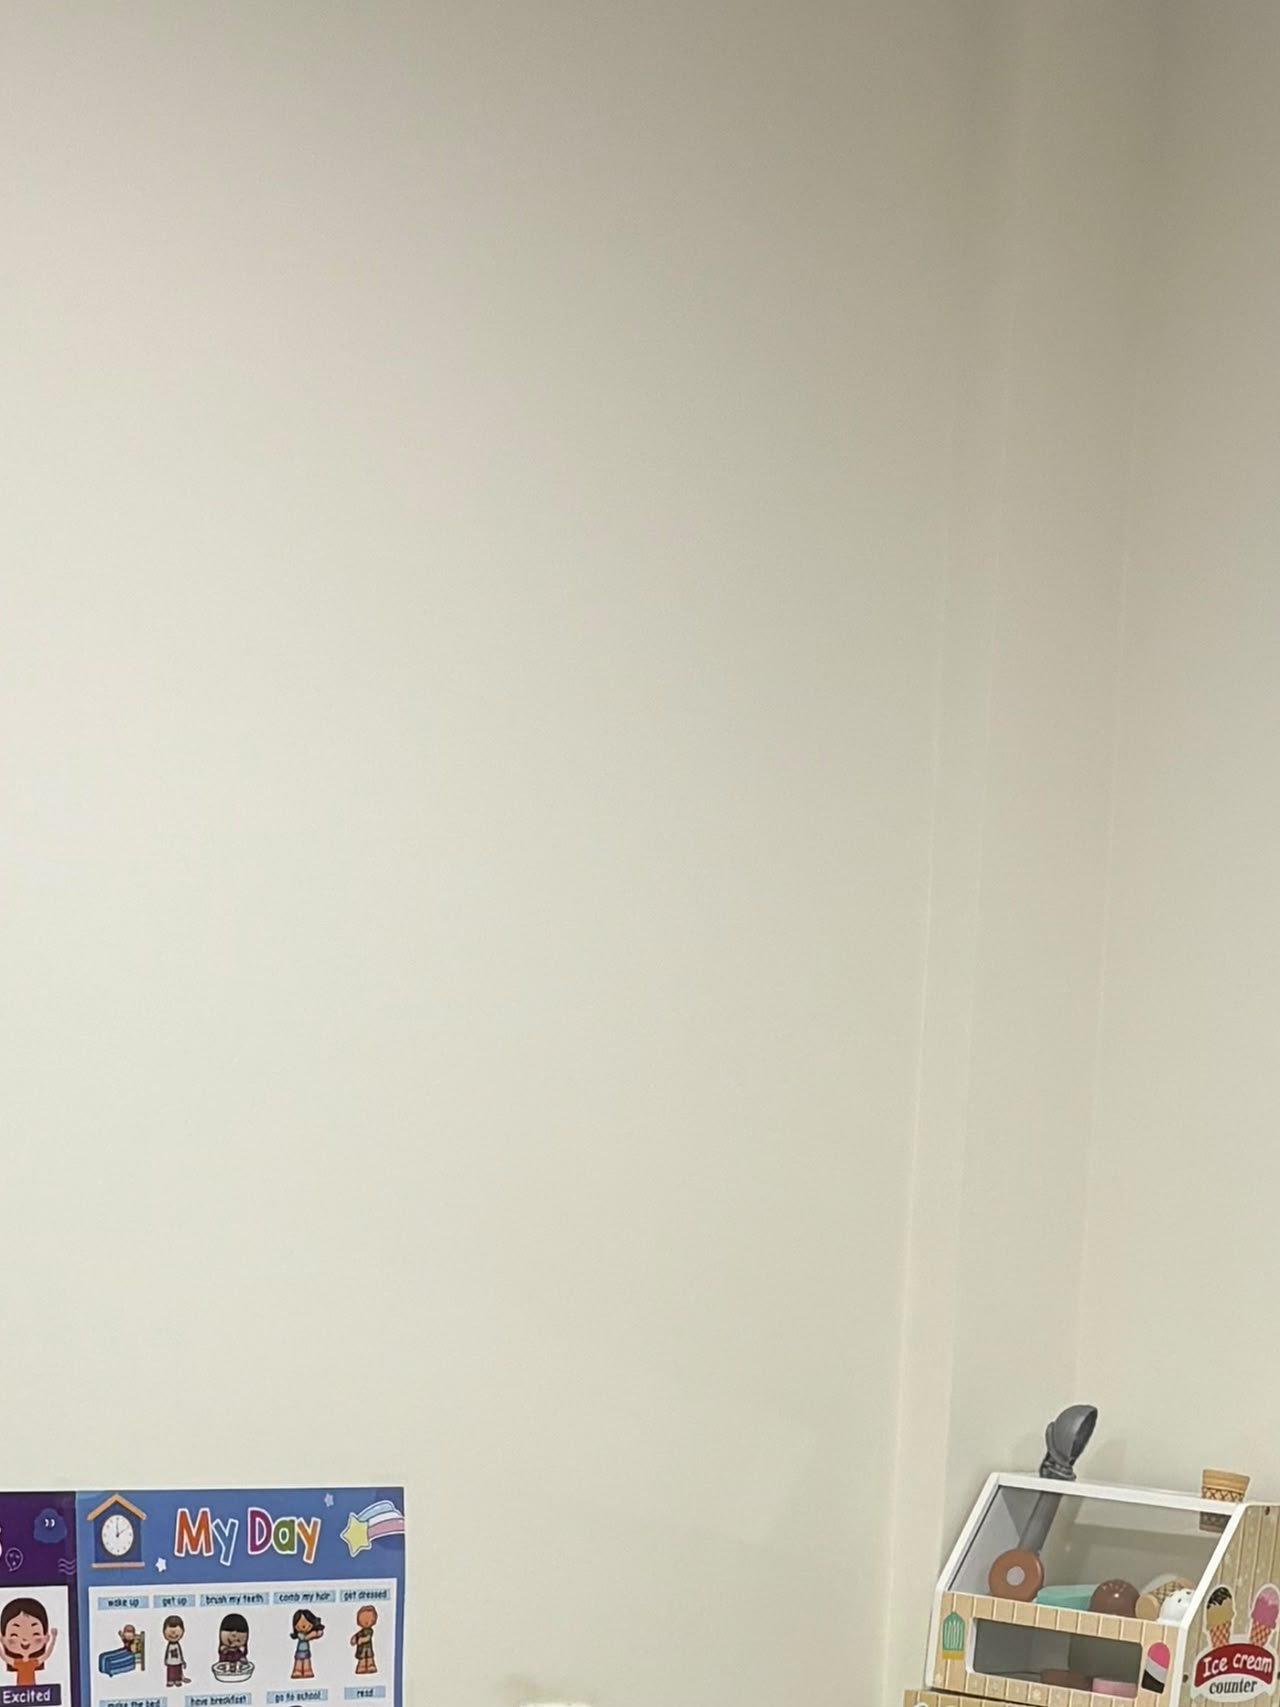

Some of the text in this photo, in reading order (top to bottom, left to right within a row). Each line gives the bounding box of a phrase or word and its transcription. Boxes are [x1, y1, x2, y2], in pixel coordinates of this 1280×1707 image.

[175, 1508, 321, 1565] My Day
[1202, 1650, 1273, 1678] Ice cream
[3, 1689, 50, 1704] Excited
[1209, 1677, 1259, 1695] counter
